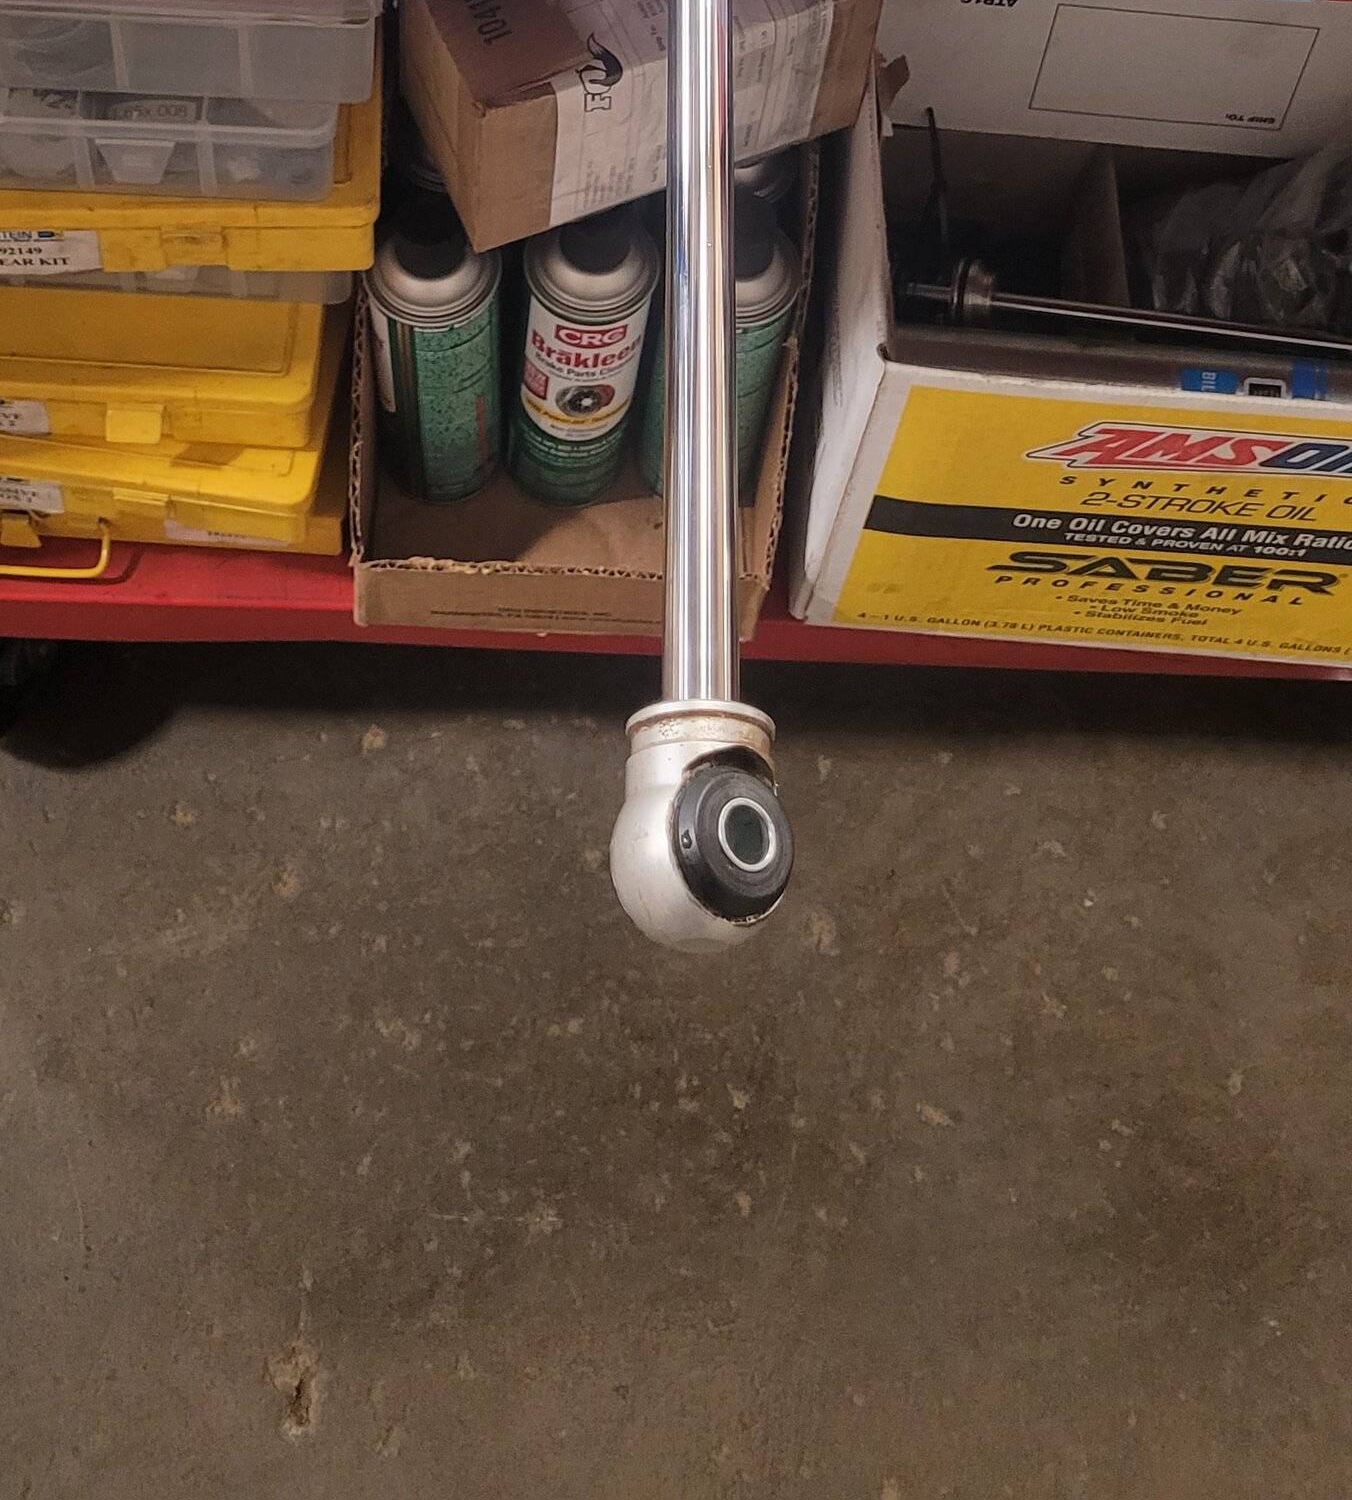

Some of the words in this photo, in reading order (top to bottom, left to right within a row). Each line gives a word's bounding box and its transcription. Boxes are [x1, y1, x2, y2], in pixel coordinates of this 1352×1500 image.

[40, 257, 69, 266] KIT
[557, 326, 626, 347] CRC
[567, 368, 597, 378] Parts
[1081, 491, 1264, 518] 2-STROKE
[1266, 503, 1317, 521] OIL
[1012, 514, 1062, 529] One
[1069, 514, 1107, 532] Oil
[1111, 518, 1196, 539] Covers
[1200, 525, 1236, 542] All
[1242, 529, 1291, 546] Mix
[1064, 532, 1132, 545] TESTED
[1135, 536, 1146, 546] &
[1151, 538, 1224, 552] PROVEN
[1229, 544, 1251, 553] AT
[1253, 545, 1308, 558] 100:1
[986, 550, 1340, 595] SABER
[994, 574, 1305, 606] PROFESSIONAL
[1067, 595, 1119, 607] Saves
[1122, 598, 1166, 610] Time
[1169, 601, 1183, 611] &
[1185, 602, 1243, 617] Money
[1084, 609, 1166, 624] Stabilizes
[1169, 615, 1208, 627] Fuel
[1100, 604, 1136, 615] Low
[1140, 606, 1199, 619] Smoke
[927, 617, 982, 628] GALLON
[1038, 624, 1095, 635] PLASTIC
[1191, 634, 1235, 645] TOTAL
[1279, 642, 1343, 654] GALLONS
